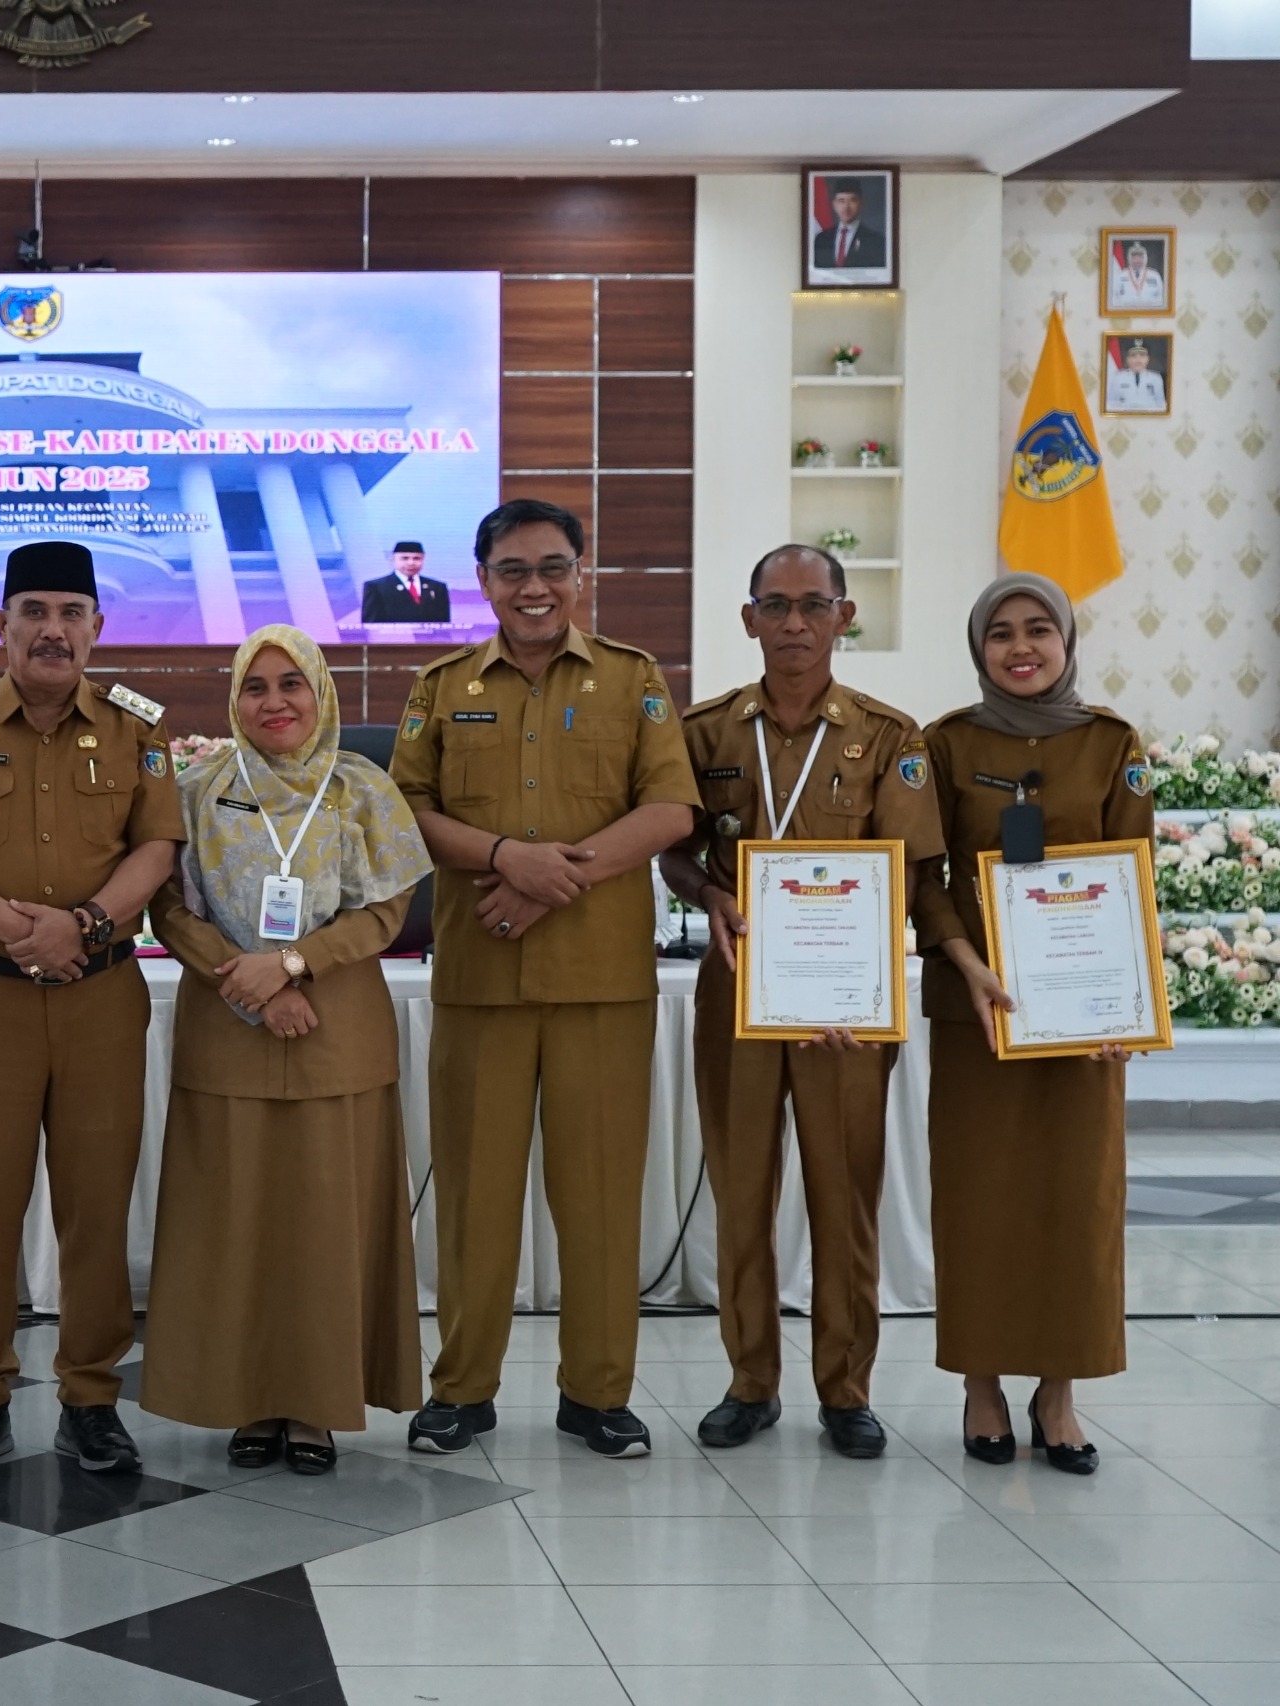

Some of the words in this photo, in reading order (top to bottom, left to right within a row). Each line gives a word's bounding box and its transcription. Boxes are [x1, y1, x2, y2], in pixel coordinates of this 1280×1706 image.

[267, 427, 479, 455] DONGGALA
[60, 465, 150, 491] 2025
[800, 887, 842, 895] PIAGAM
[1047, 892, 1089, 903] PIAGAM
